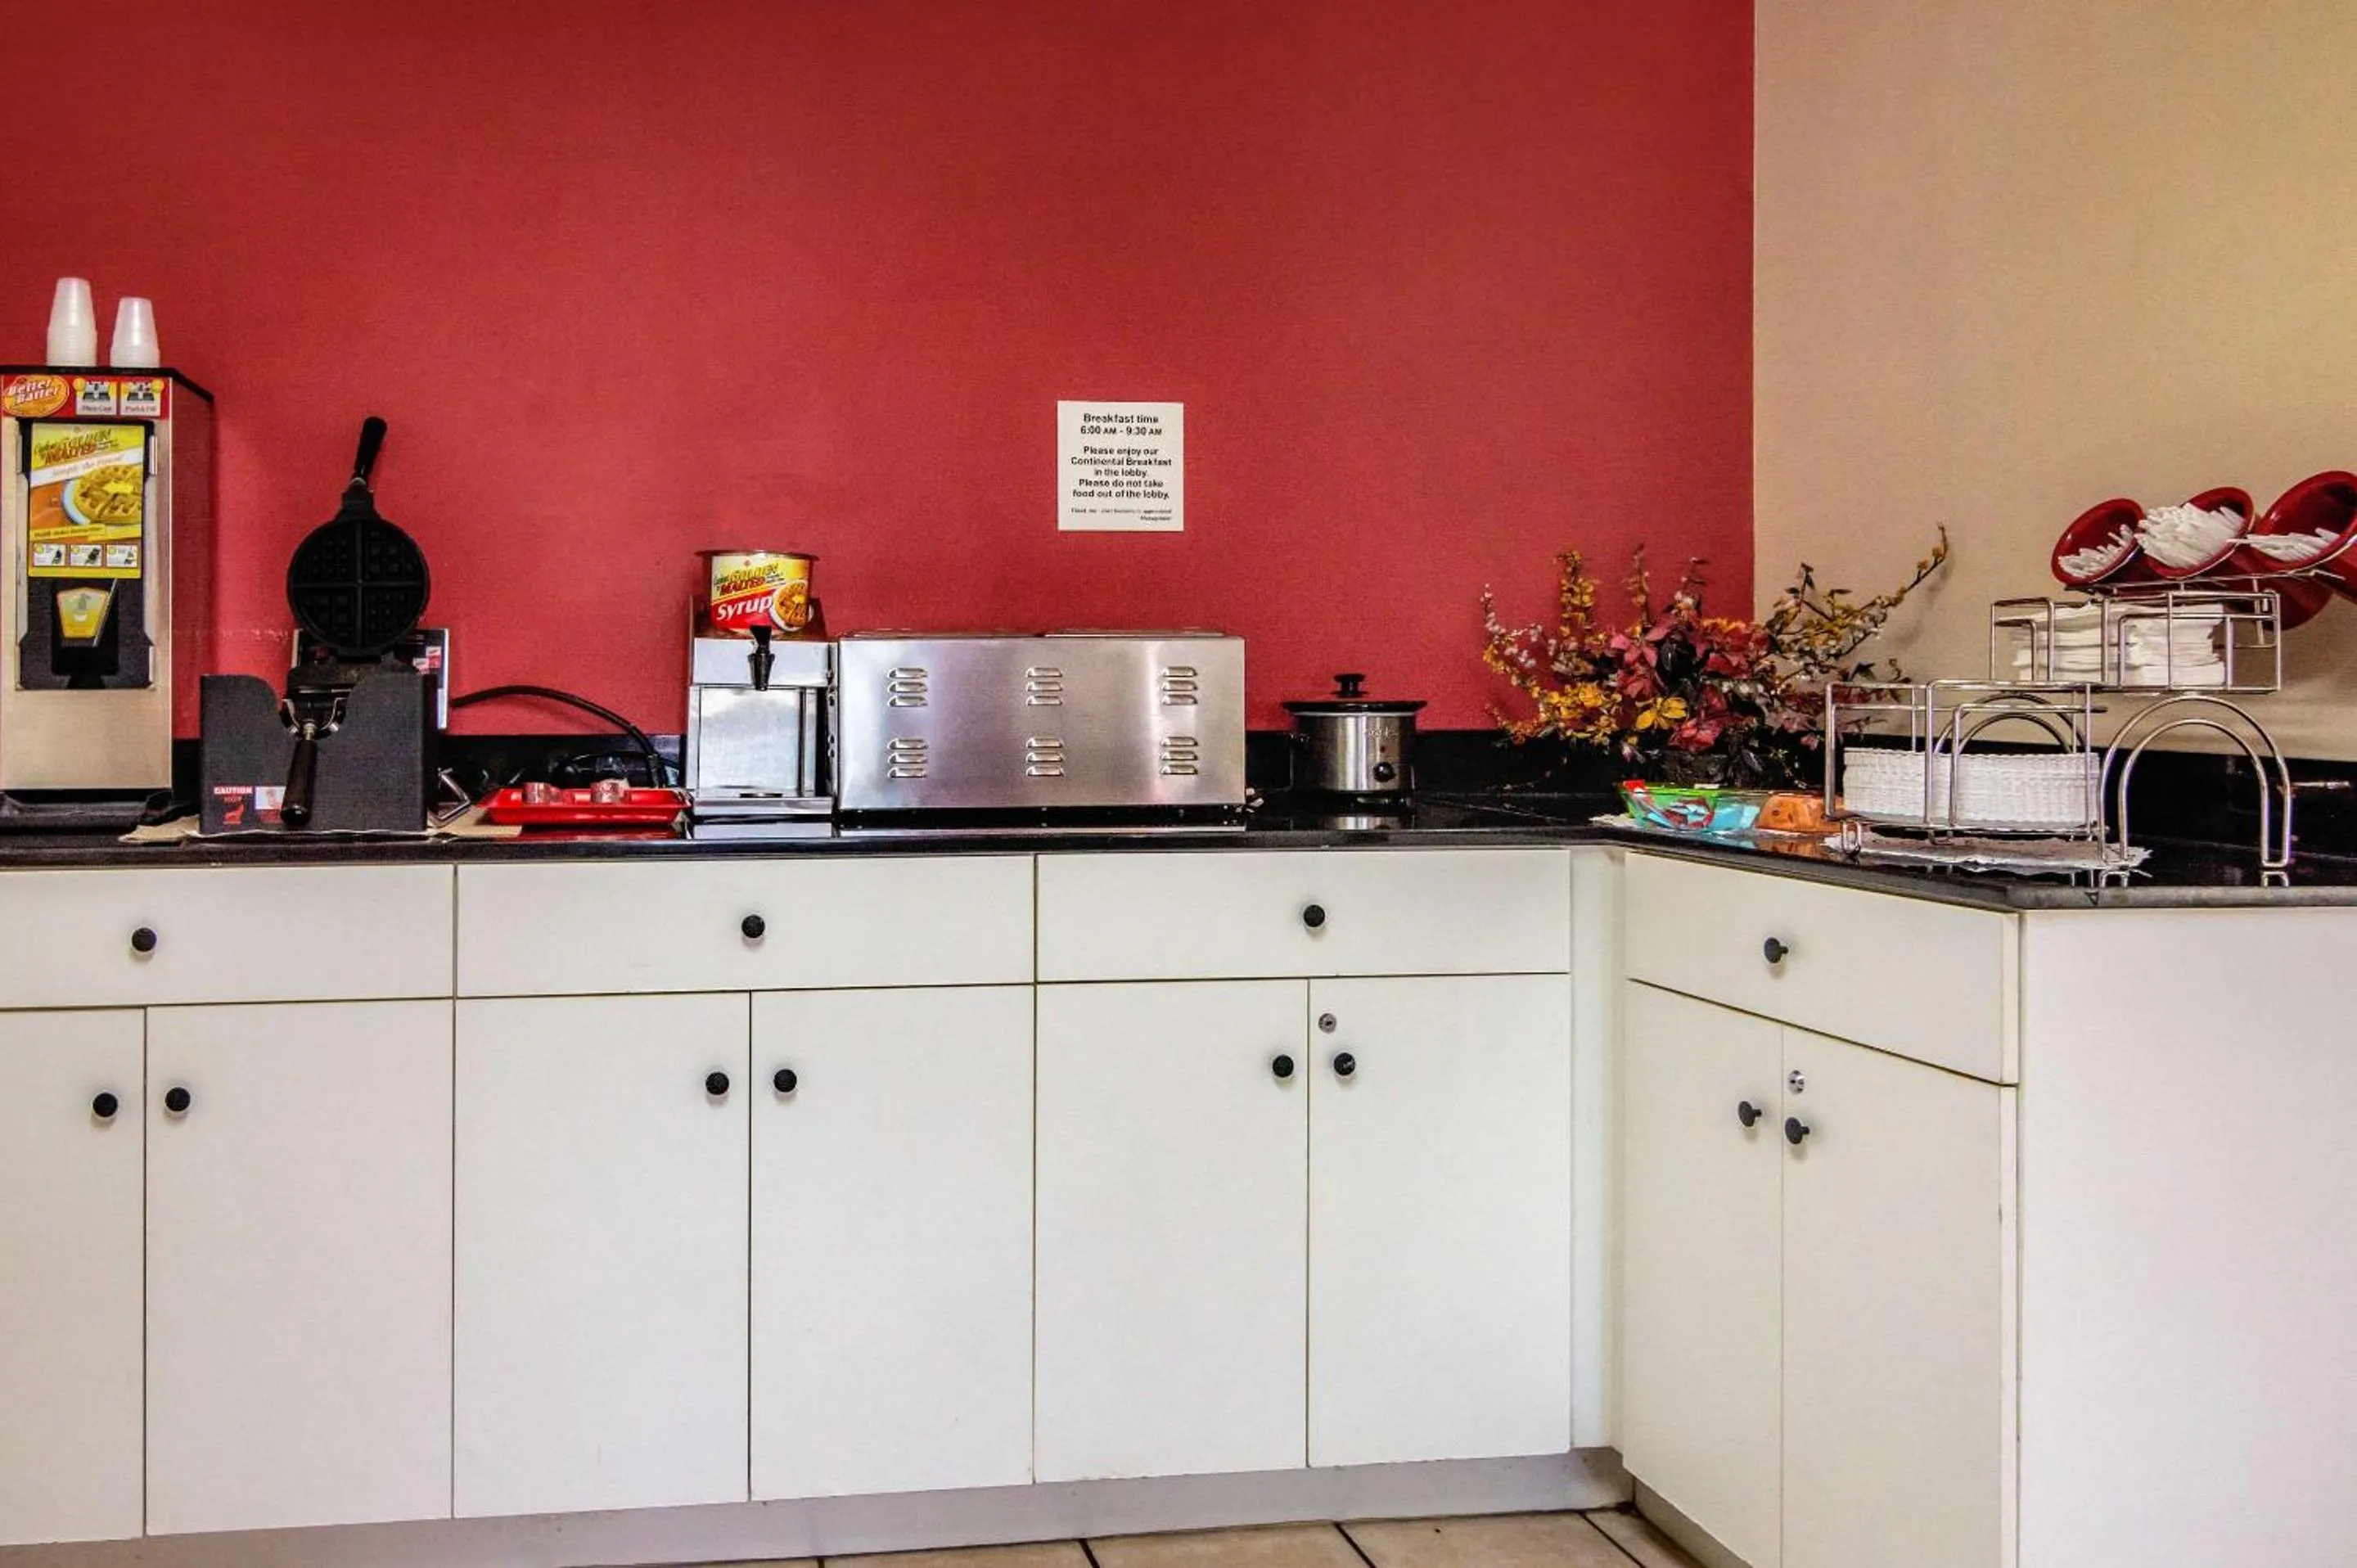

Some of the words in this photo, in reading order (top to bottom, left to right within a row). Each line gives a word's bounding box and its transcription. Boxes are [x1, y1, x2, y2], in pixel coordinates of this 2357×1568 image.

[1084, 413, 1134, 423] Breakfast
[1137, 415, 1159, 423] time
[1080, 426, 1101, 435] 6:00
[1126, 426, 1146, 435] 9:30
[1084, 446, 1114, 455] Please
[1117, 447, 1141, 456] enjoy
[1071, 457, 1124, 466] Continental
[1126, 457, 1172, 466] Breakfast
[1094, 468, 1102, 476] in
[1105, 468, 1119, 476] the
[1079, 479, 1110, 487] Please
[1112, 479, 1124, 487] do
[1073, 489, 1094, 498] food
[1126, 490, 1141, 498] the
[1143, 490, 1169, 500] lobby.
[716, 595, 773, 620] Syrup
[214, 786, 253, 795] CAUTION
